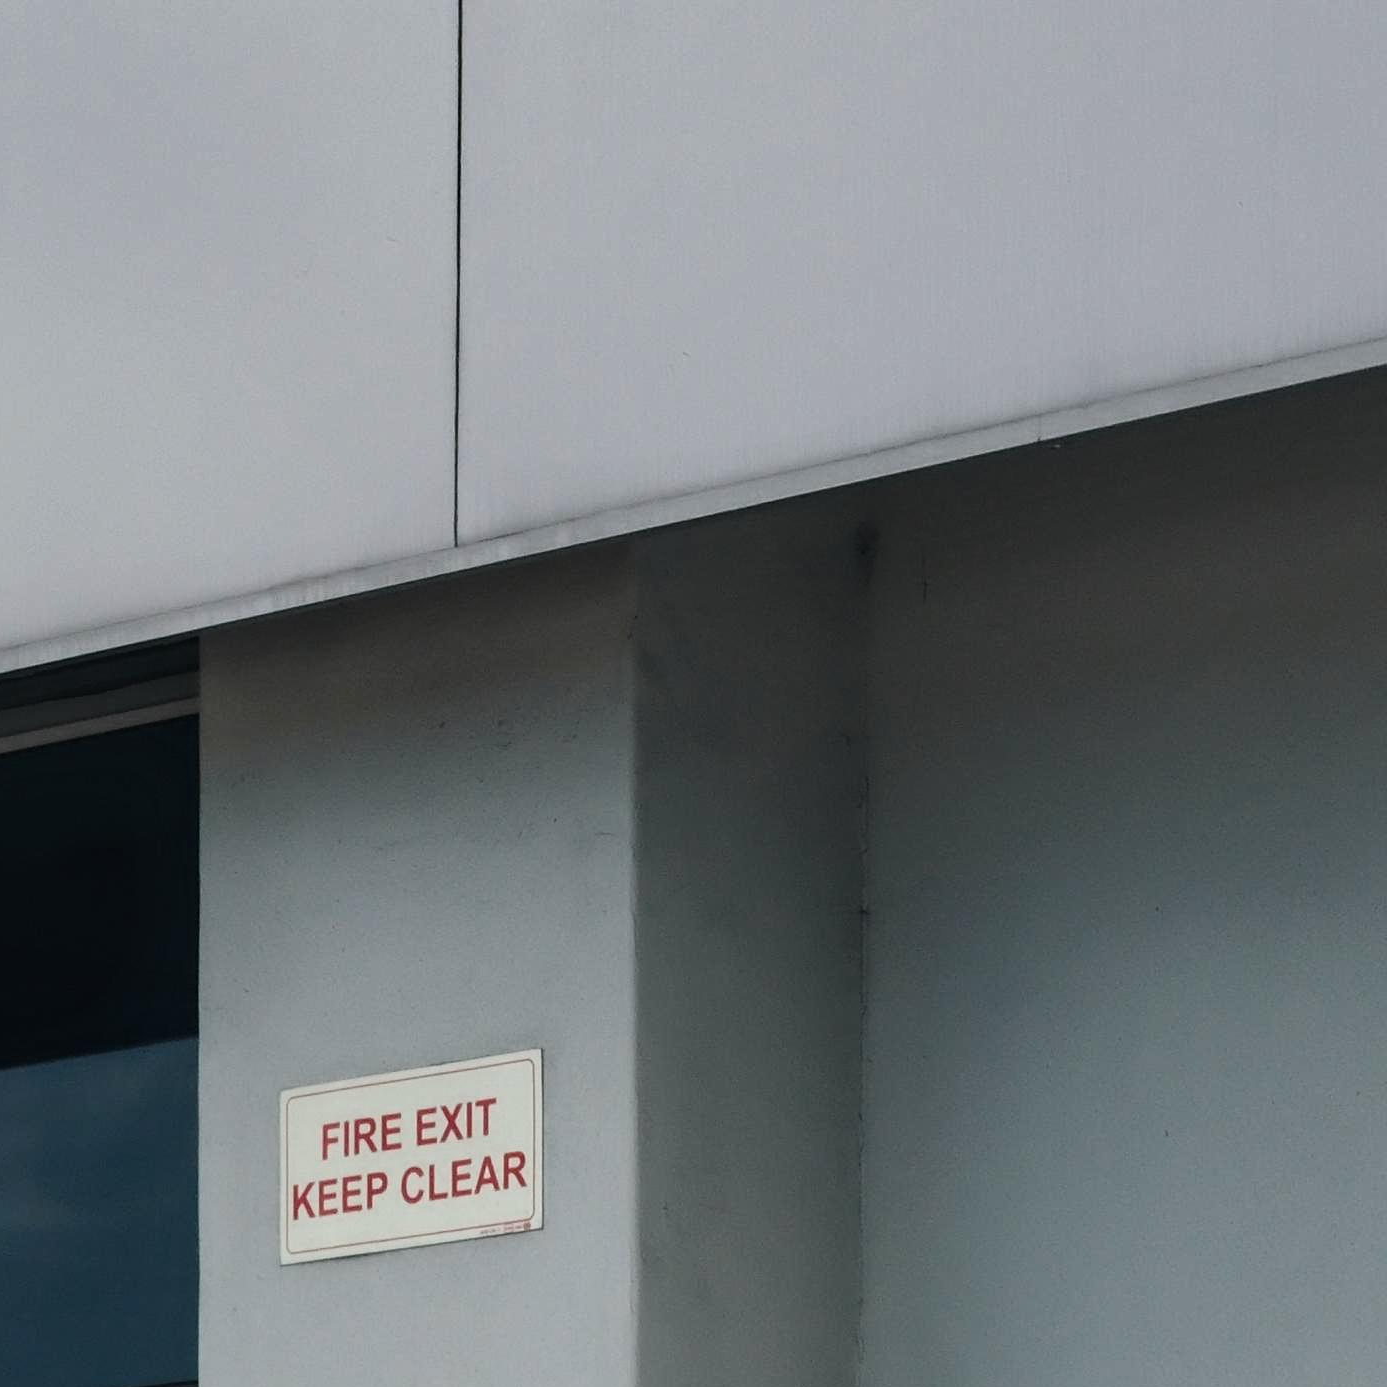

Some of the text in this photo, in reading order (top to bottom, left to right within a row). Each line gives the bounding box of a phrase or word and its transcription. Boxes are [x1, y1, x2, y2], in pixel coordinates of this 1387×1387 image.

[322, 1098, 497, 1161] FIRE EXIT
[292, 1151, 527, 1220] KEEP CLEAR
